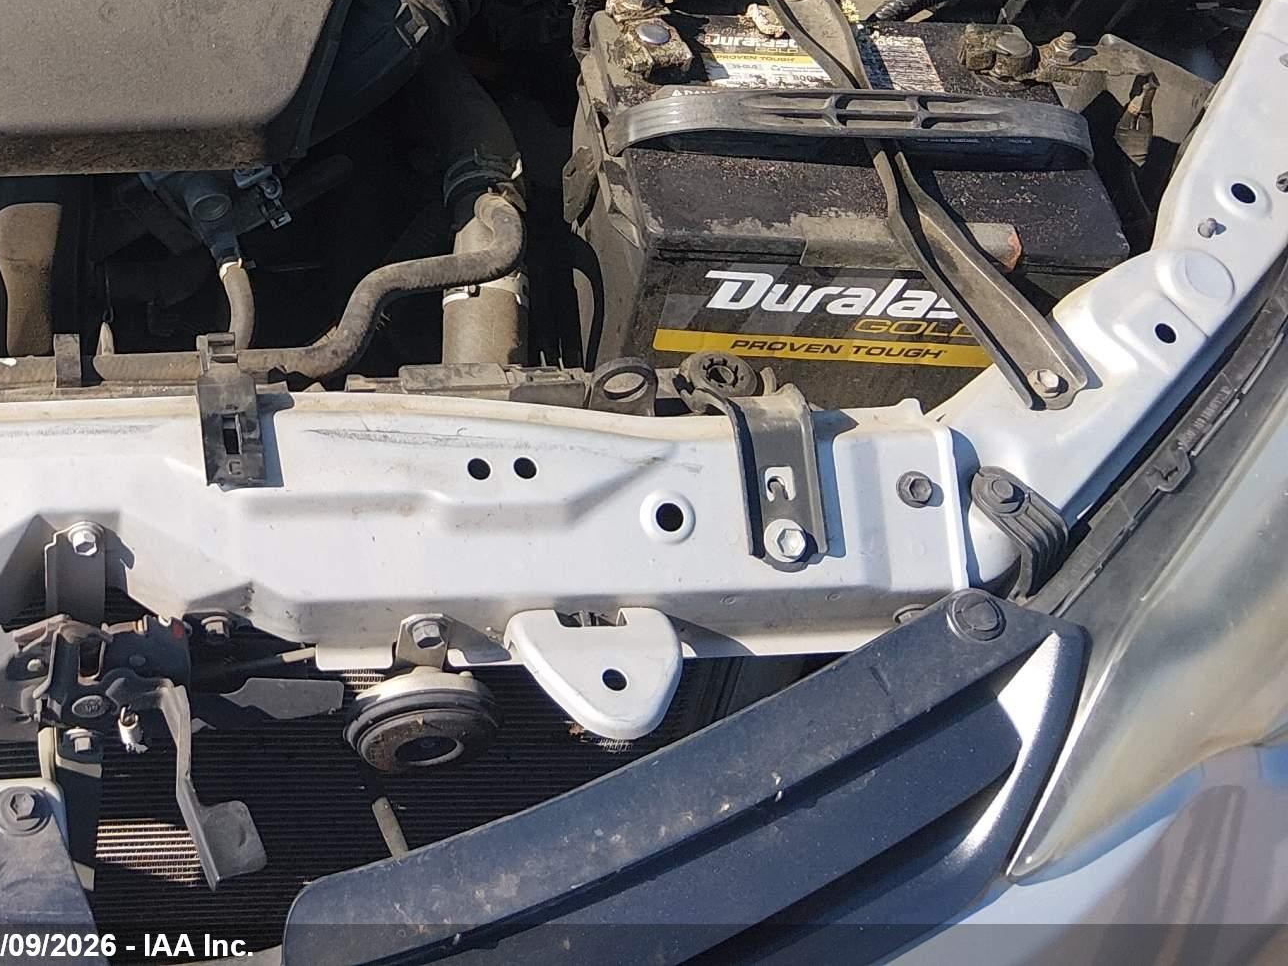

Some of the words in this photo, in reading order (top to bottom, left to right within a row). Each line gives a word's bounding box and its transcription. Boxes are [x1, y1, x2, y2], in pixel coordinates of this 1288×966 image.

[704, 270, 958, 319] Duralas
[729, 339, 844, 357] PROVEN
[852, 345, 945, 359] TOUGH
